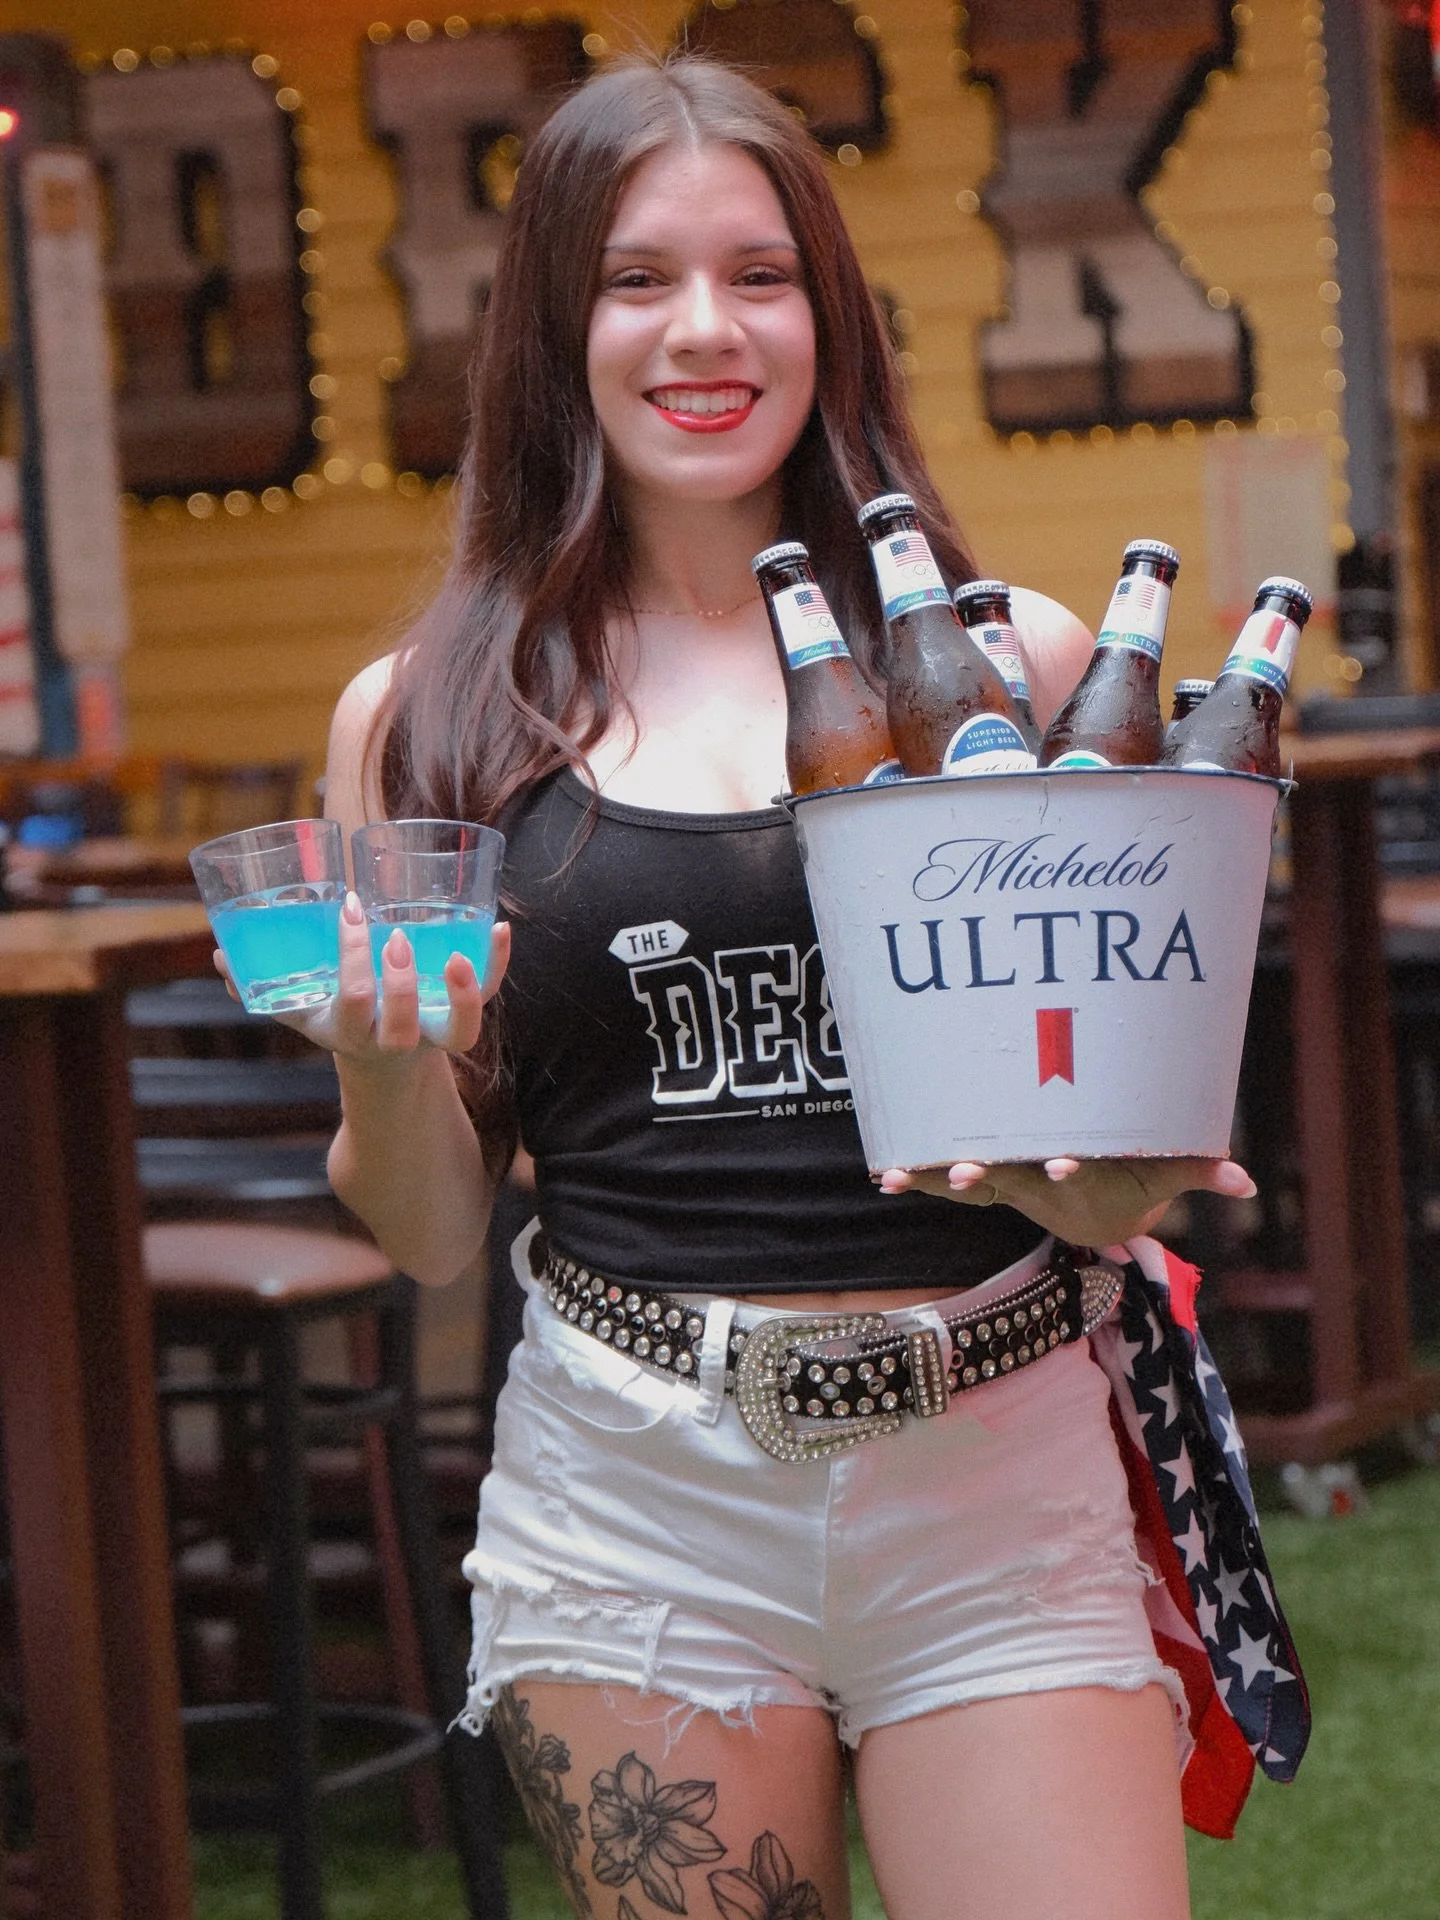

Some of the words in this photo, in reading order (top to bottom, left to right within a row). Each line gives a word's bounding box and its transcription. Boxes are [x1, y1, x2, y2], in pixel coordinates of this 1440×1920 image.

[1125, 634, 1158, 654] ULTRA
[966, 738, 995, 750] LIGHT
[998, 736, 1017, 744] BEER
[967, 727, 1011, 740] SUPERIOR
[912, 833, 1175, 902] Michelob
[627, 929, 669, 954] THE
[880, 908, 1207, 994] ULTRA
[760, 1104, 797, 1118] SAN
[804, 1100, 855, 1114] DIEGO
